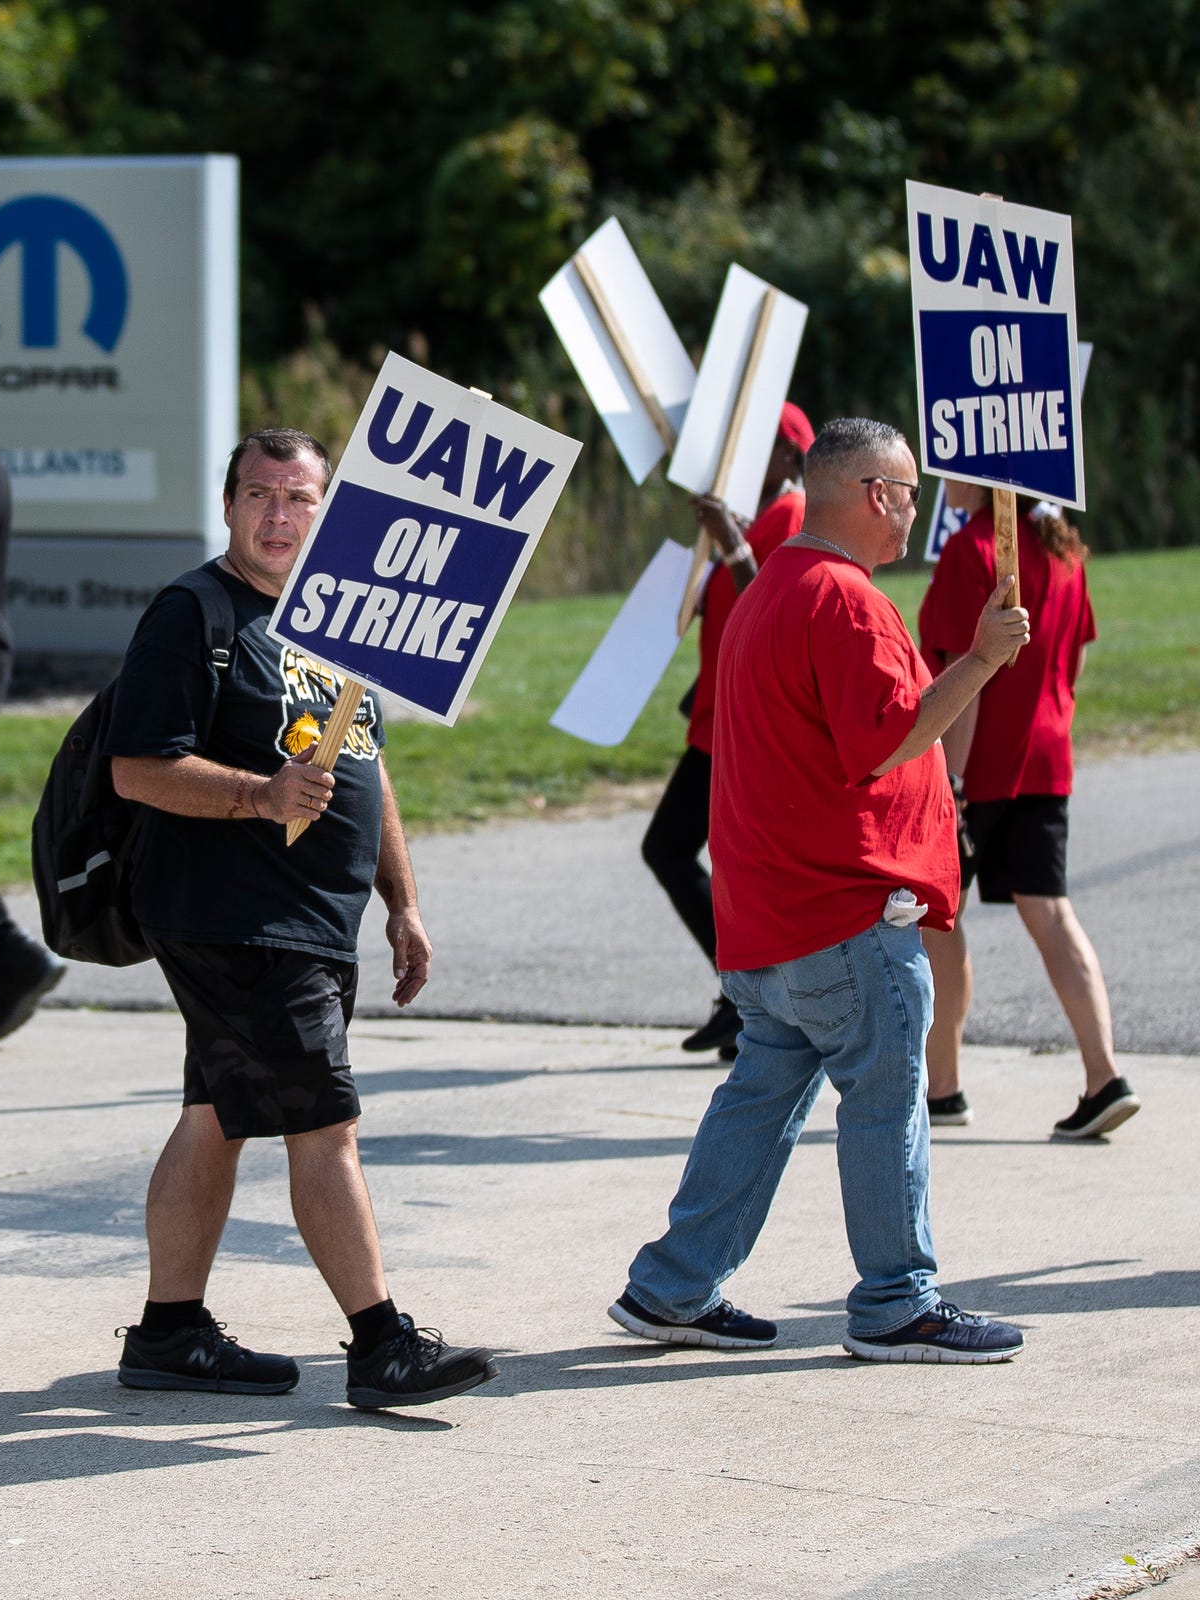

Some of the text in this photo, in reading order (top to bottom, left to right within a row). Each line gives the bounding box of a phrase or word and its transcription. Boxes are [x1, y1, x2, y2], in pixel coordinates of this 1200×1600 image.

[916, 211, 1060, 306] UAW
[969, 323, 1023, 387] ON
[366, 385, 556, 523] UAW
[931, 389, 1068, 460] STRIKE
[373, 517, 461, 586] ON
[77, 578, 161, 607] Stree
[289, 572, 485, 664] STRIKE
